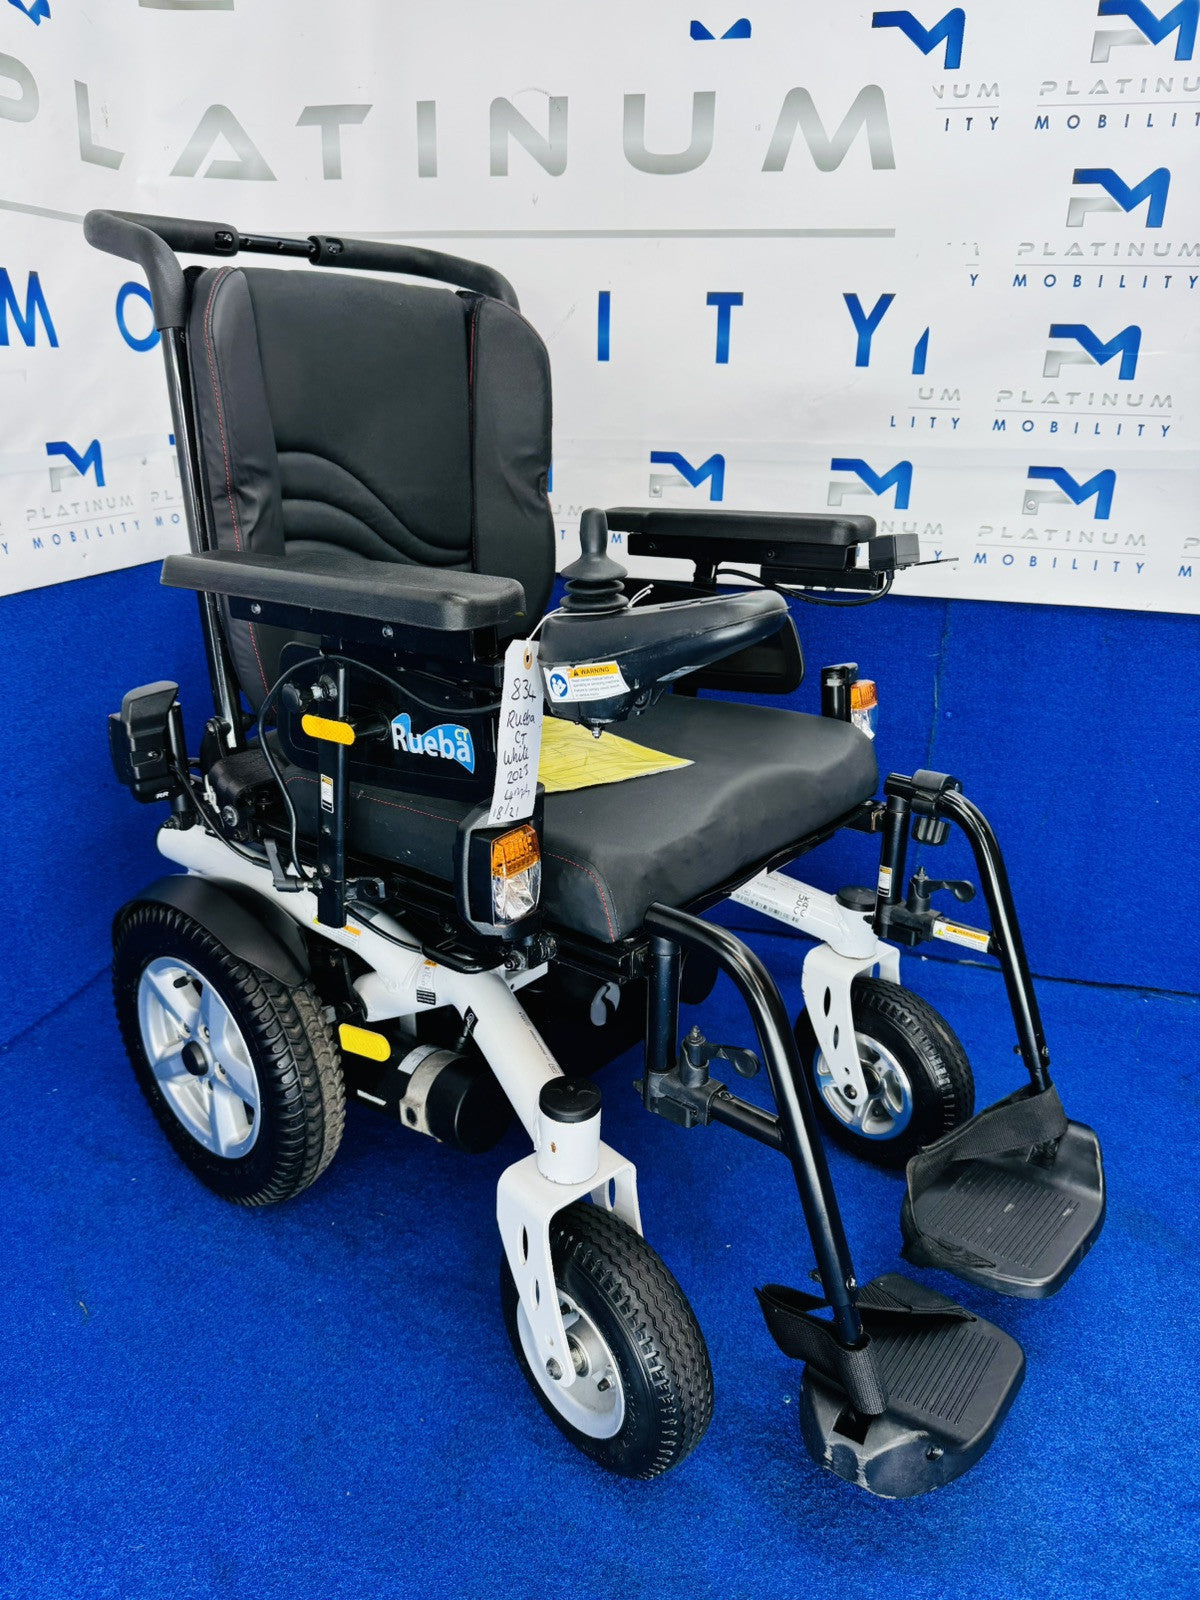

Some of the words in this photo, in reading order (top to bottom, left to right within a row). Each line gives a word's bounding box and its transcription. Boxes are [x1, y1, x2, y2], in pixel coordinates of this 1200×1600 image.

[1017, 242, 1200, 257] PLATINUM
[1013, 274, 1199, 289] MOBILITY
[996, 390, 1173, 408] PLATINUM
[992, 419, 1171, 438] MOBILITY
[26, 495, 135, 522] PLATINUM
[32, 519, 142, 550] MOBILITY
[977, 525, 1147, 547] PLATINUM
[974, 552, 1145, 575] MOBILITY
[511, 677, 537, 702] 834
[391, 722, 472, 763] Rueba
[454, 728, 469, 742] CT
[514, 730, 528, 745] CT
